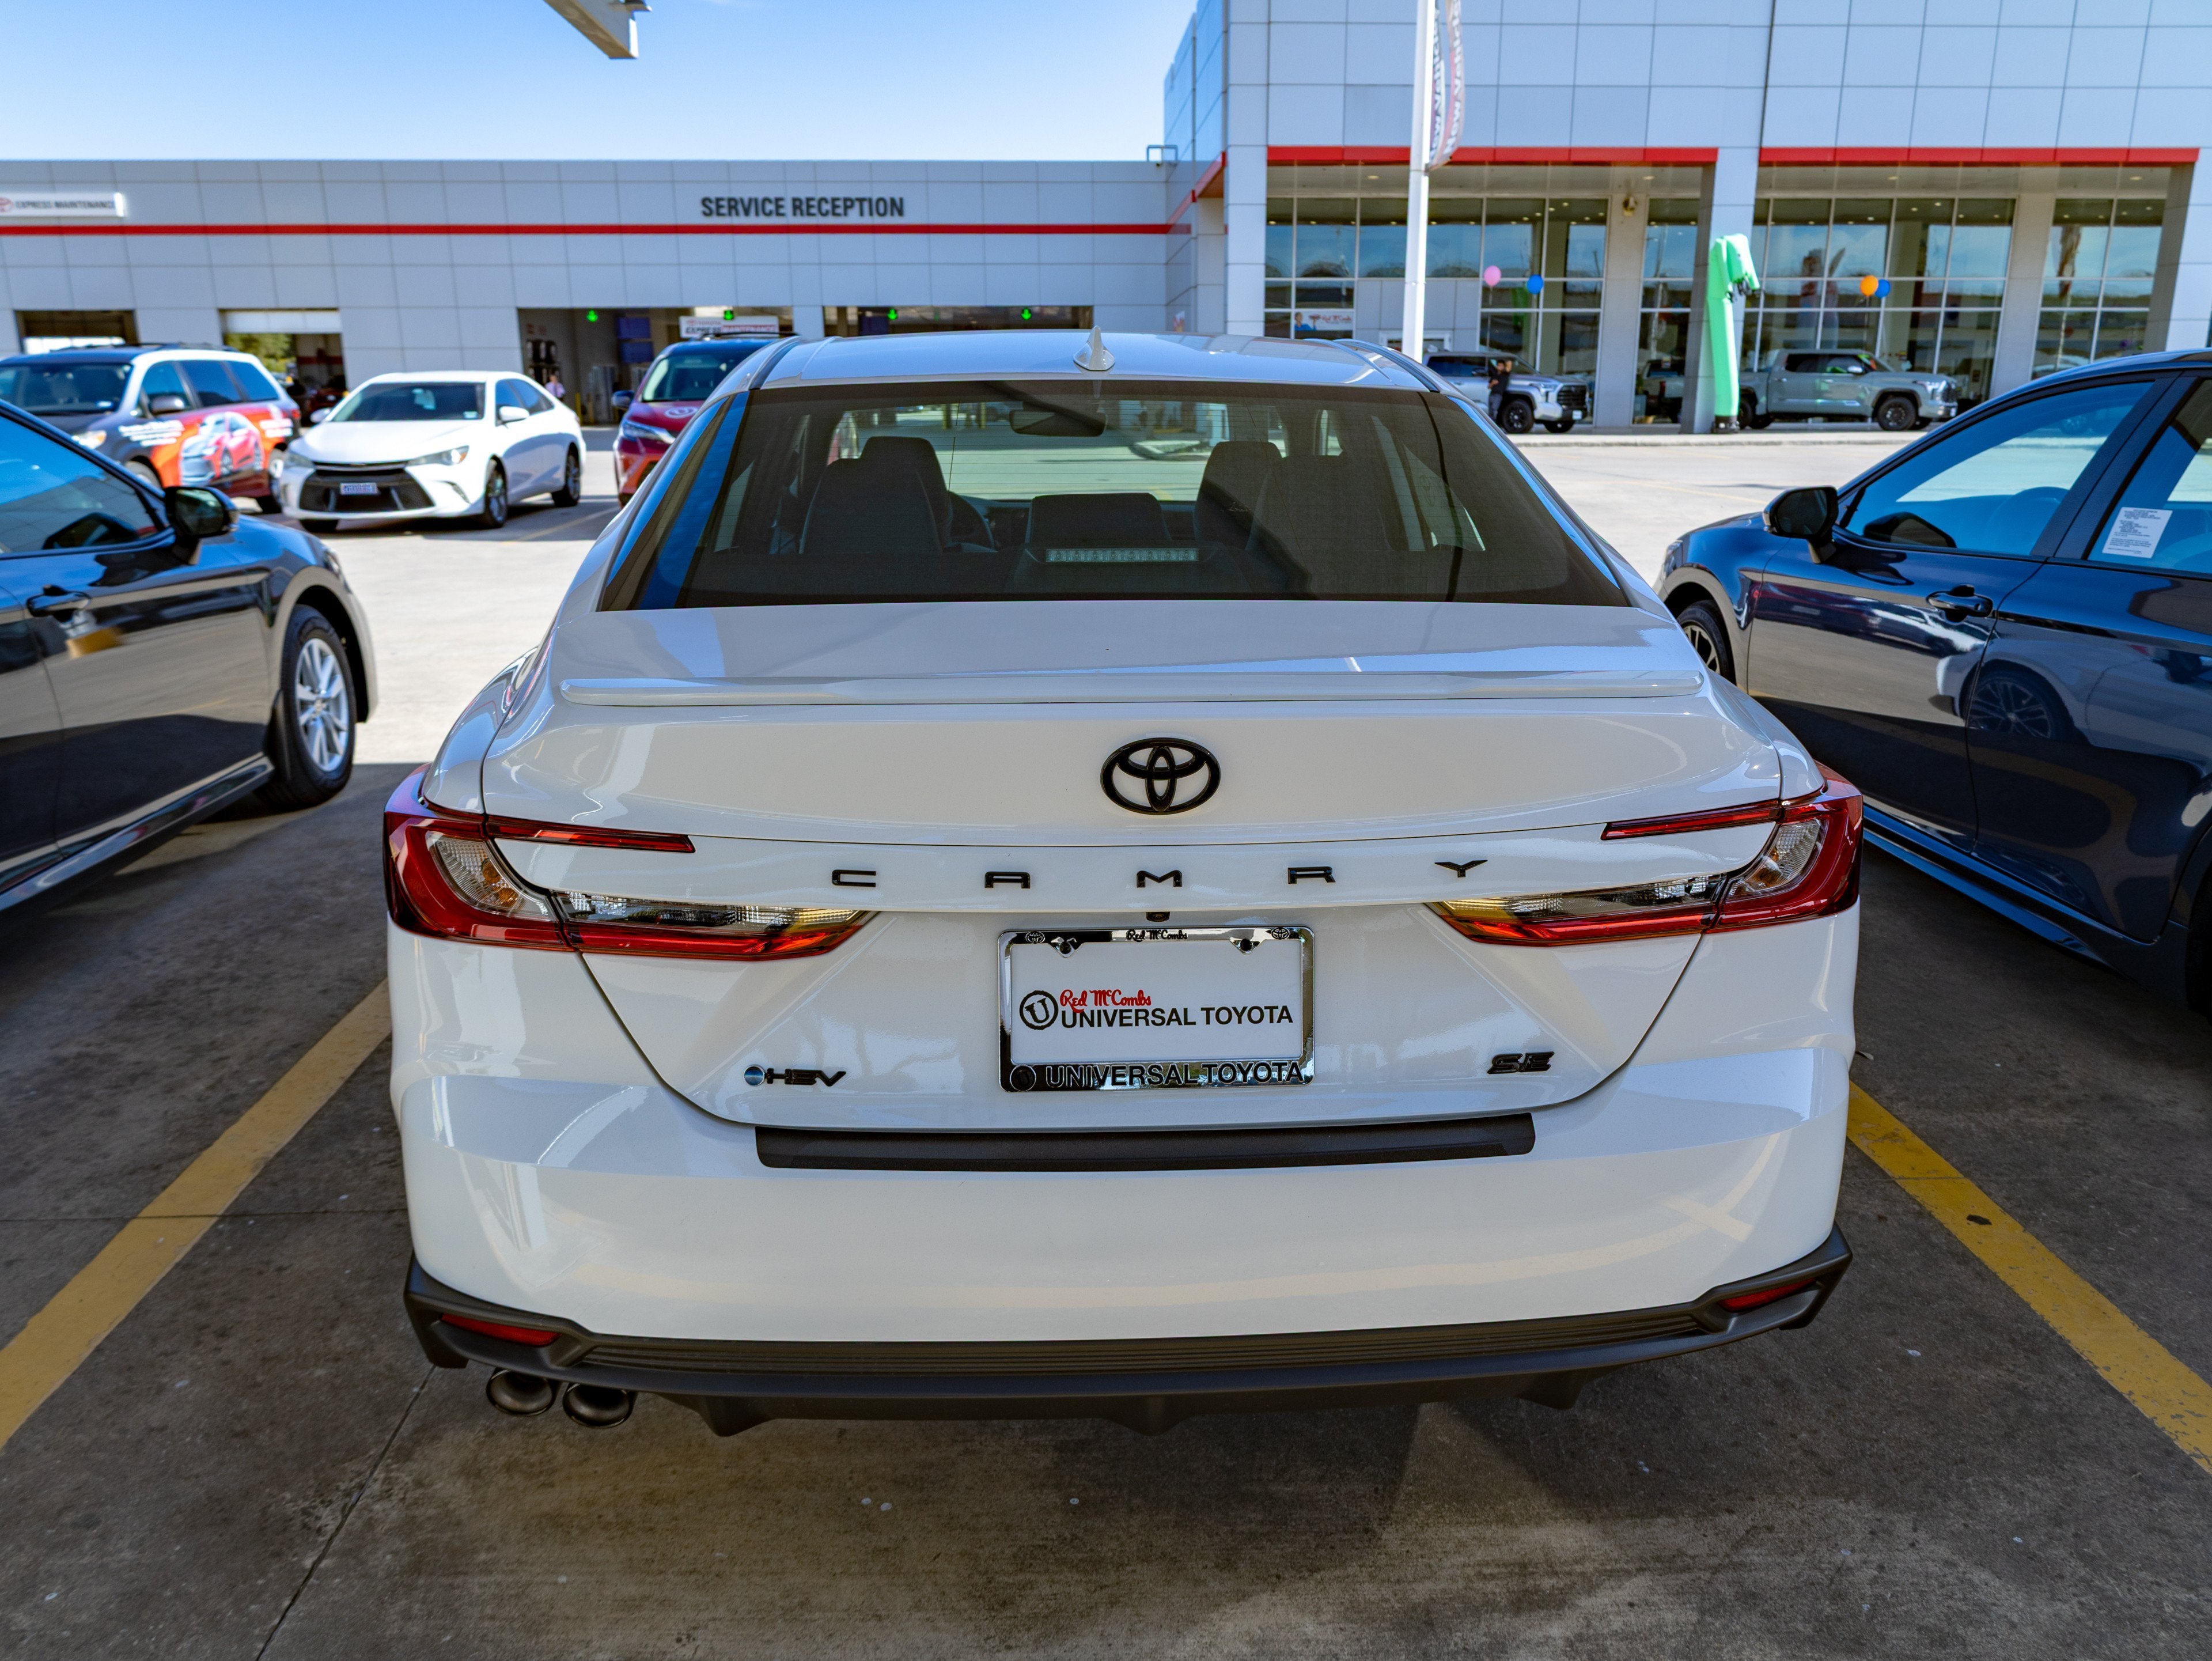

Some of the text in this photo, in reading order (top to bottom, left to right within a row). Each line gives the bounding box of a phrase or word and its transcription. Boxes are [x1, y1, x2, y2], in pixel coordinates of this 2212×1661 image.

[1442, 99, 1461, 155] New
[701, 196, 904, 217] SERVICE RECEPTION
[831, 859, 1488, 889] CAMRY
[1126, 928, 1188, 943] Red McCombs
[1059, 989, 1152, 1014] Red McCombs
[1061, 1005, 1294, 1029] UNIVERSAL TOYOTA
[1046, 1060, 1304, 1088] UNIVERSAL TOYOTA
[1486, 1051, 1555, 1074] SE
[765, 1067, 847, 1087] HEV
